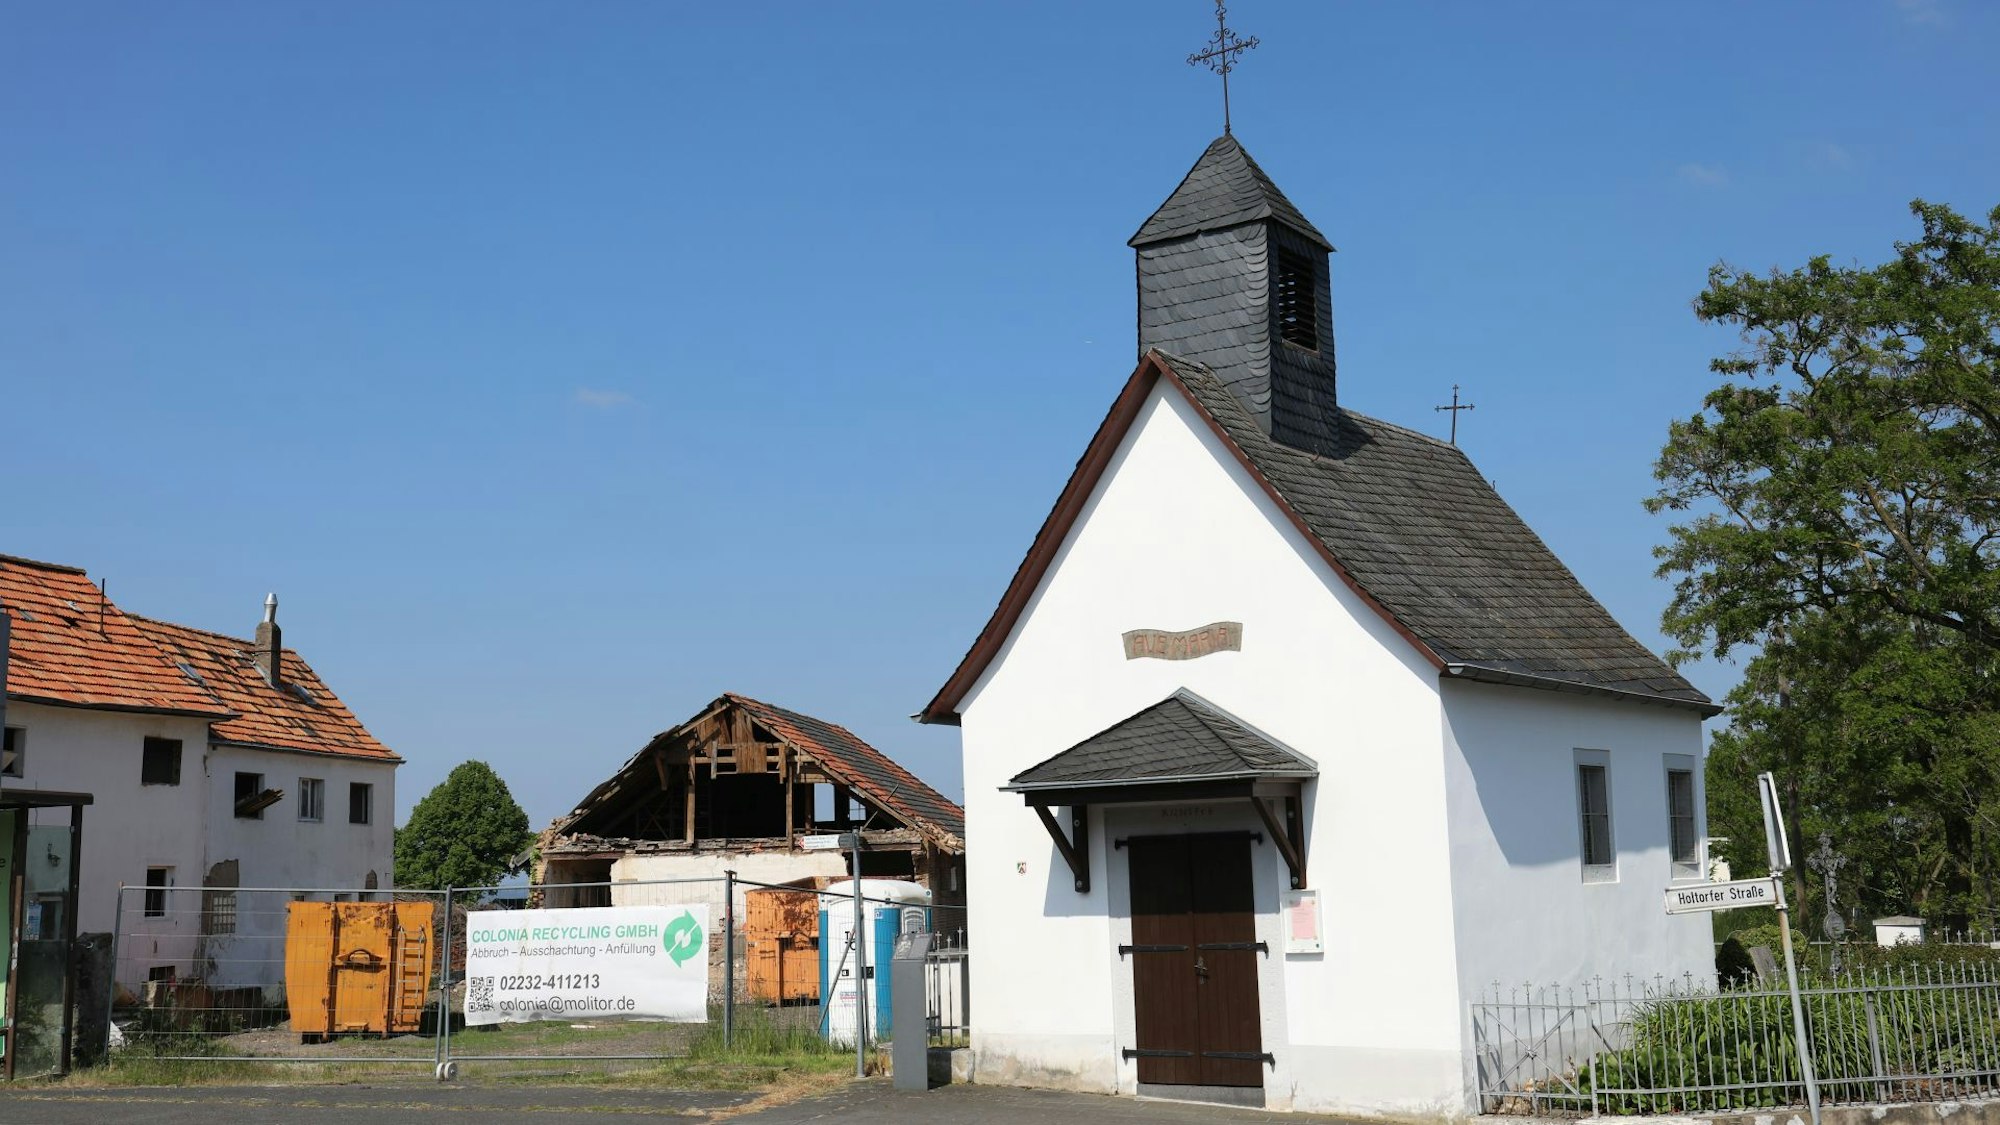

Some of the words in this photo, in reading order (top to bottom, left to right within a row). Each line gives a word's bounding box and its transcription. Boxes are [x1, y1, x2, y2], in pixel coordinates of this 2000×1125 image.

[1678, 890, 1725, 905] Holtorfer
[1729, 886, 1764, 900] Straße
[472, 928, 528, 943] COLONIA
[532, 925, 611, 940] RECYCLING
[615, 924, 658, 938] GMBH
[471, 946, 509, 958] Abbruch
[519, 944, 596, 957] Ausschachtung
[605, 943, 656, 956] Anfüllung
[500, 974, 600, 991] 02232-411213
[500, 995, 635, 1014] colonia@molitor.de
